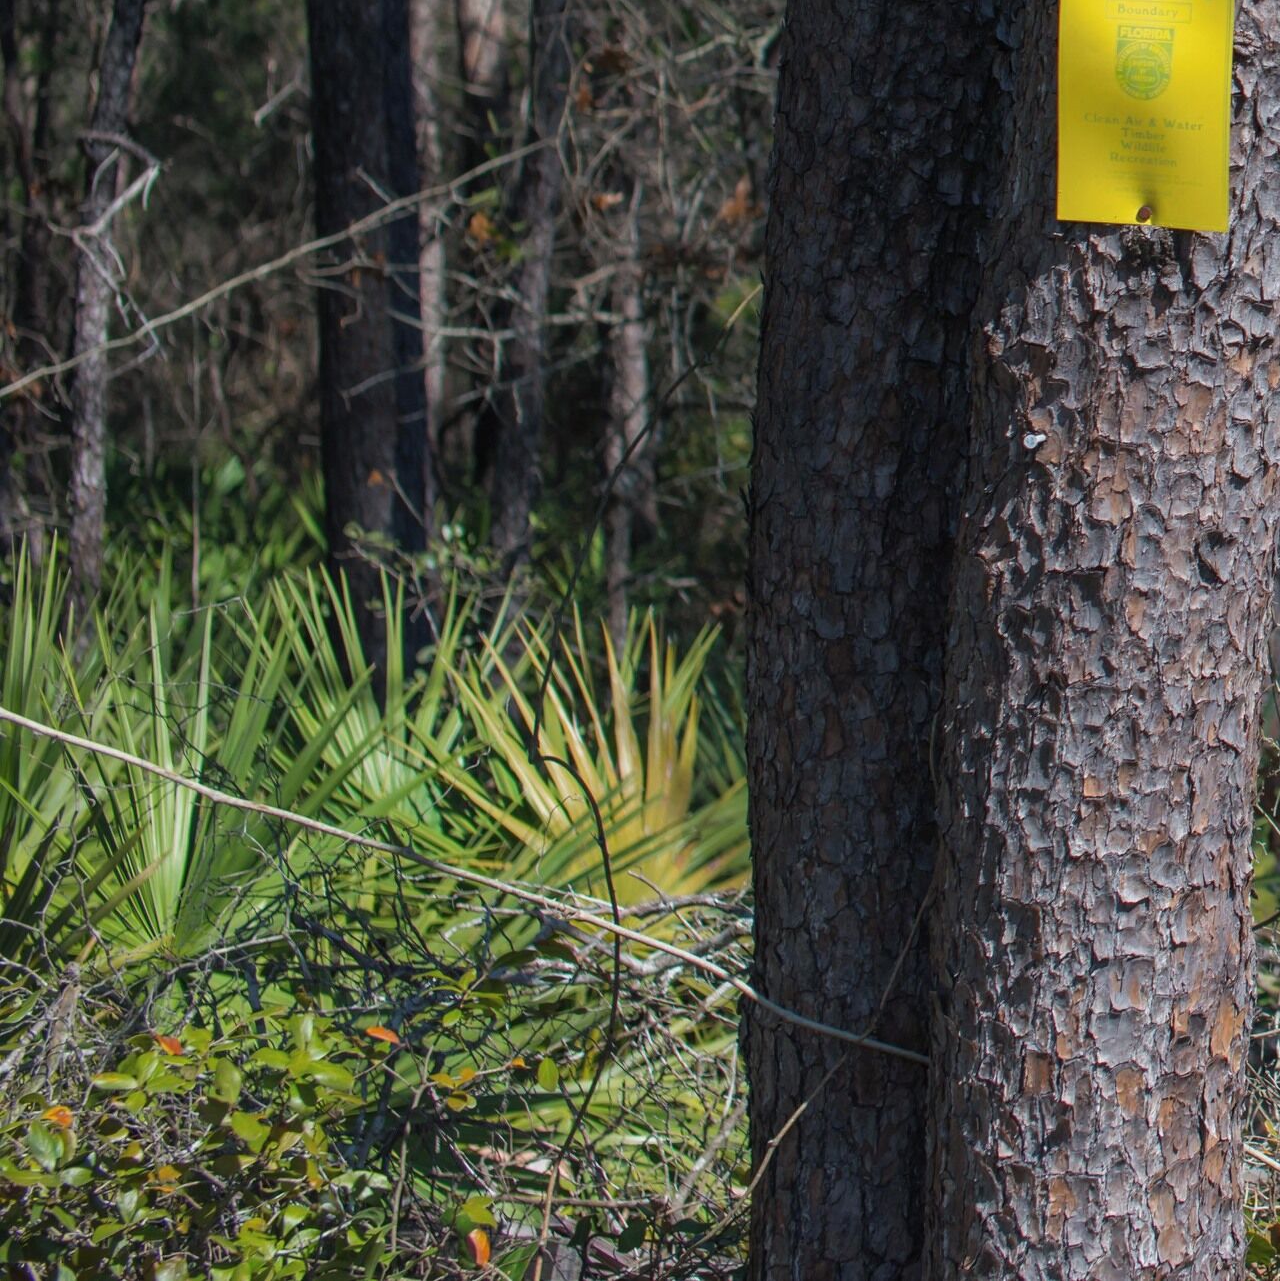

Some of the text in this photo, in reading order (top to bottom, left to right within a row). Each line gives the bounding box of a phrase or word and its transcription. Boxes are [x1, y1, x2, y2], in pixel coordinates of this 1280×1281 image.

[1117, 4, 1178, 18] Boundary
[1119, 27, 1171, 40] FLORIDA
[1084, 112, 1203, 131] Clean Air & Water
[1120, 127, 1166, 140] Timber
[1120, 139, 1168, 153] Wildlife
[1109, 152, 1178, 167] Recreation
